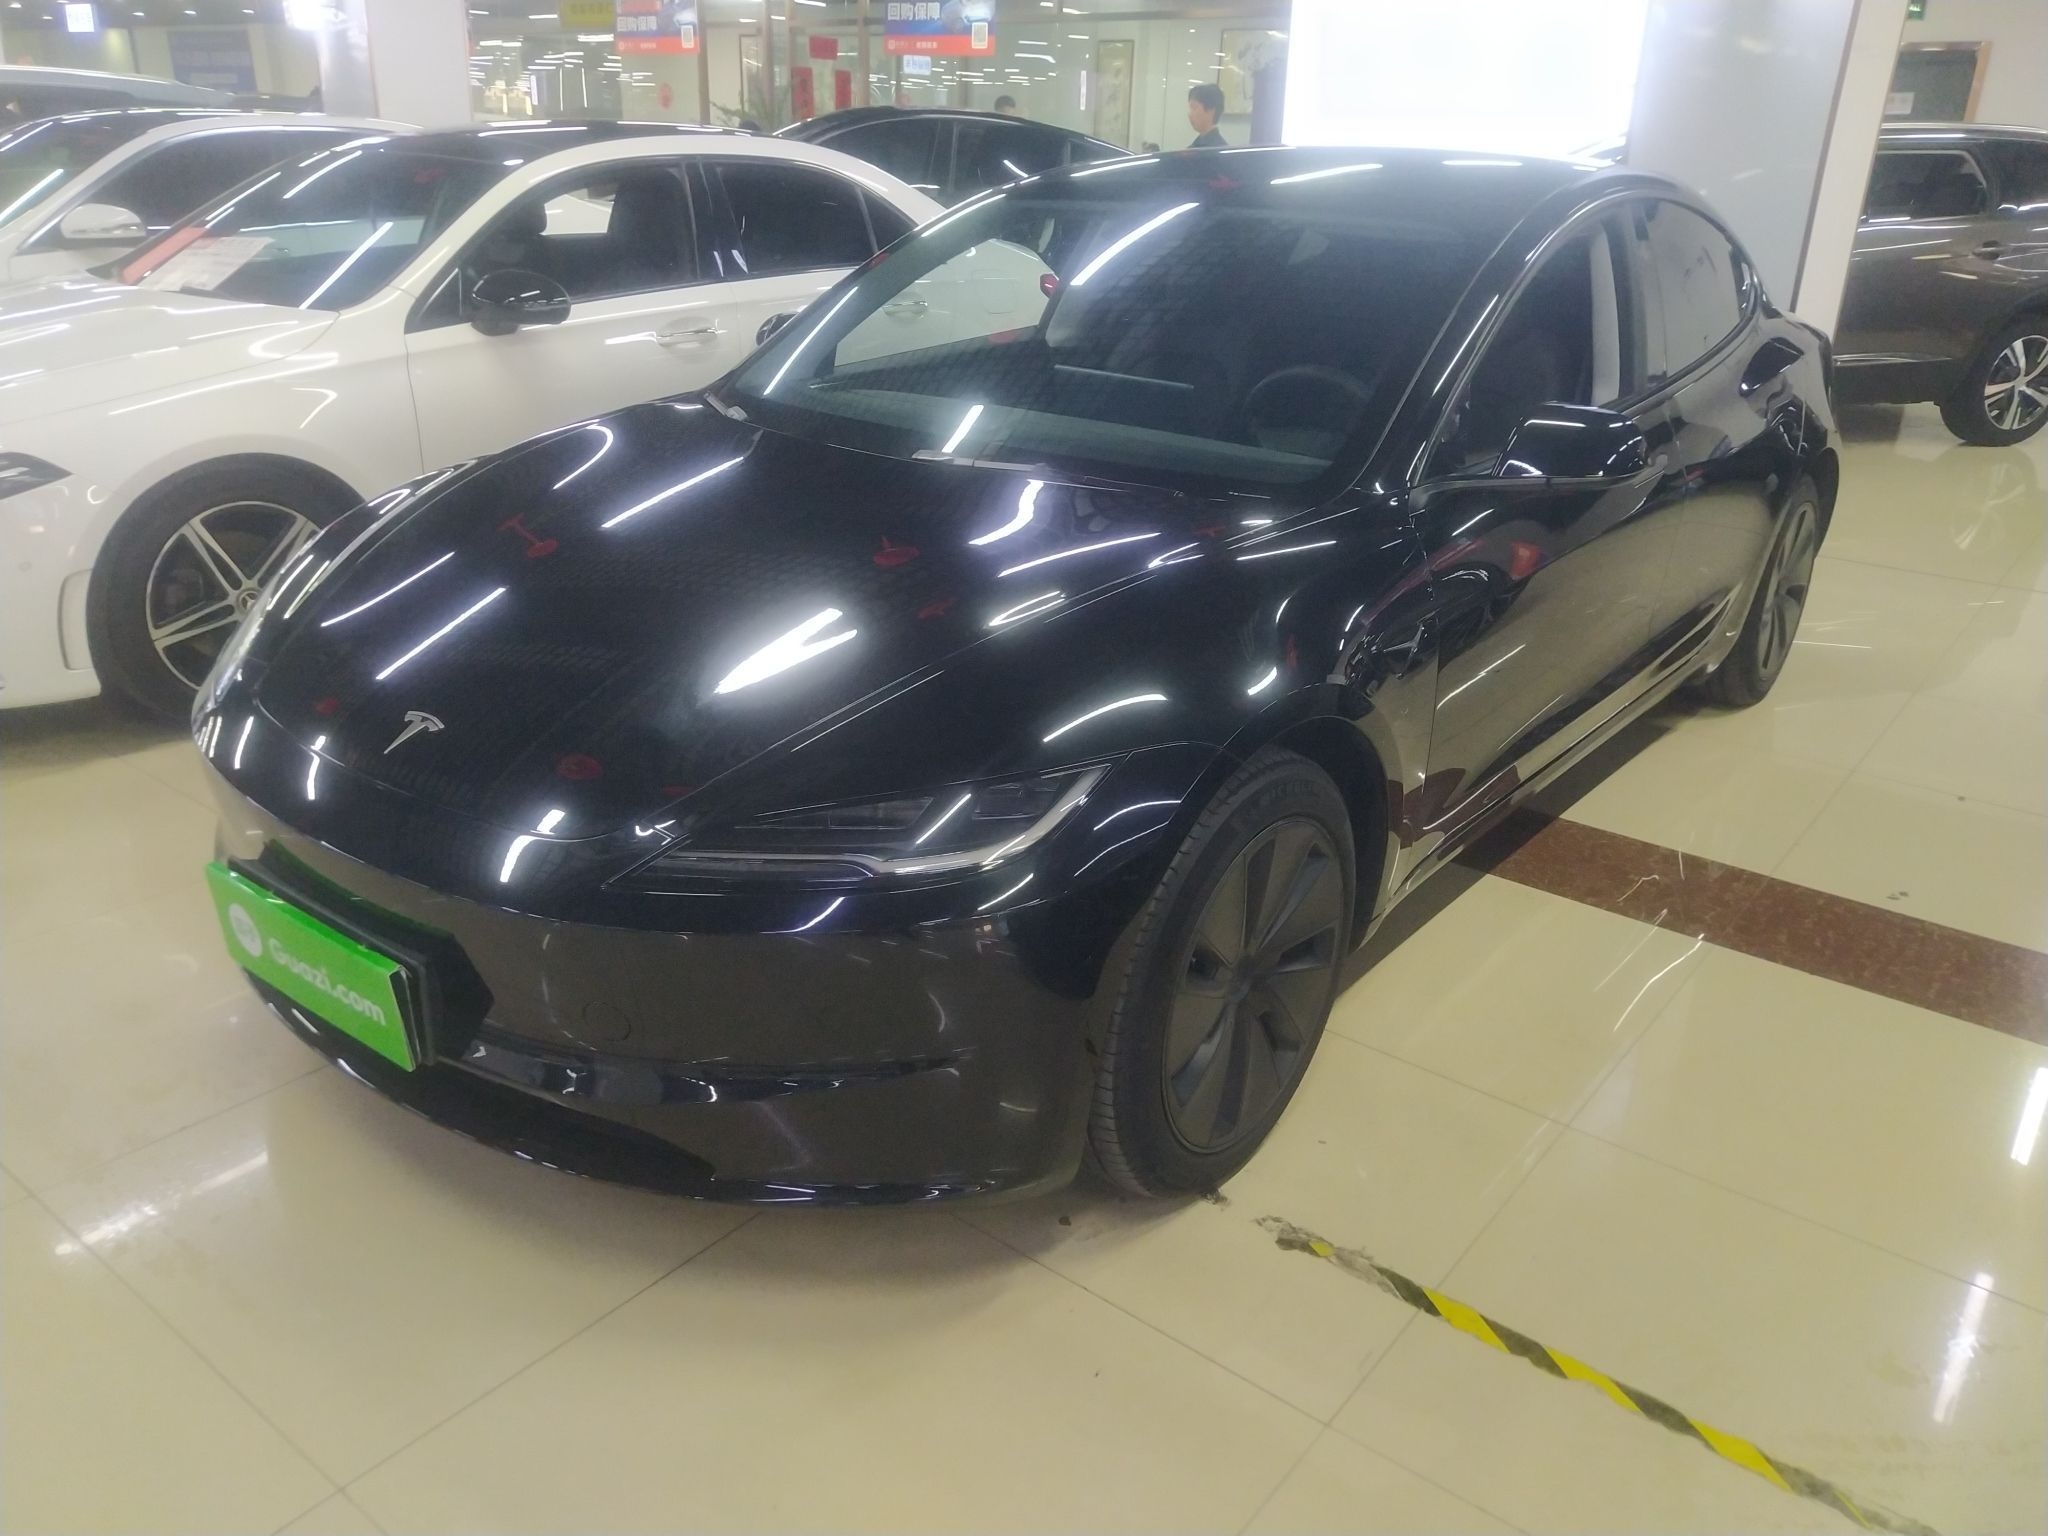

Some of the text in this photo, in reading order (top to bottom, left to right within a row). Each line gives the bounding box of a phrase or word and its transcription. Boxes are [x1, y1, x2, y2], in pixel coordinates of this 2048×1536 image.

[888, 2, 940, 21] 回购保障
[268, 938, 386, 1026] Guazi.com
